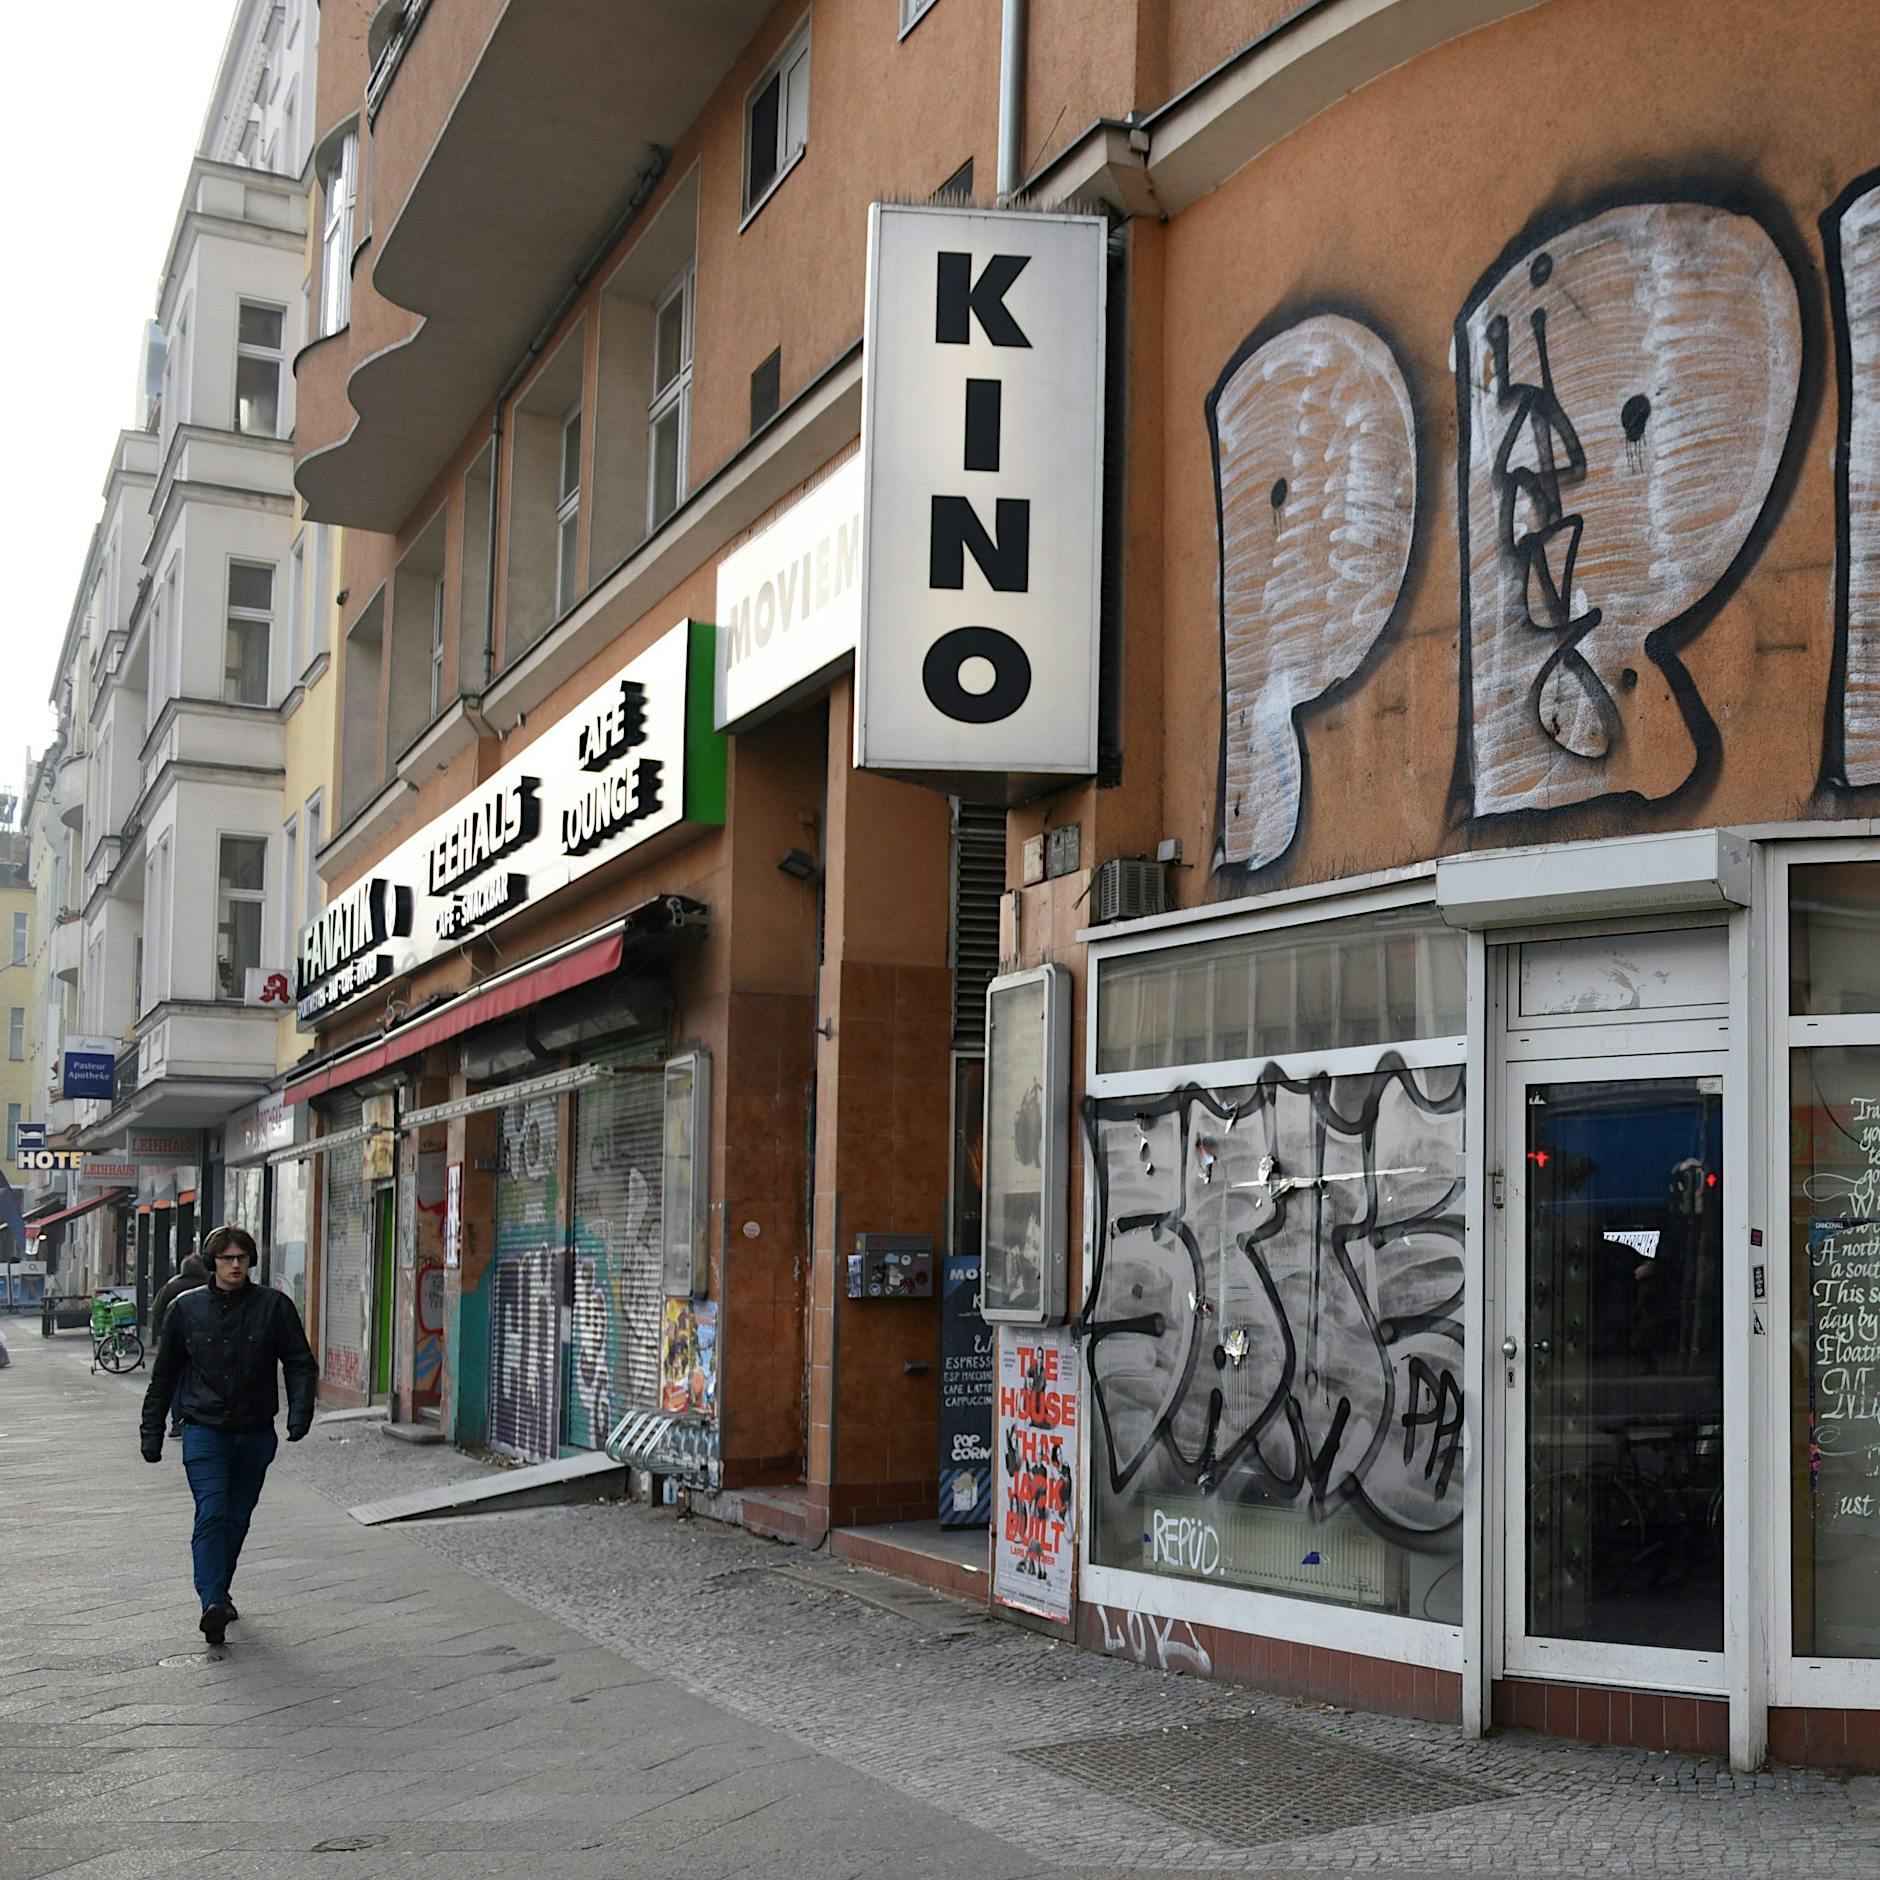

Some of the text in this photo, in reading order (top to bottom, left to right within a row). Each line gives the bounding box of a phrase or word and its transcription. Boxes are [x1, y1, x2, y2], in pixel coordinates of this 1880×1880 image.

[921, 251, 1034, 725] KINO
[557, 758, 641, 856] LOUNGE
[422, 776, 524, 895] TEEHAUS
[302, 880, 375, 988] FANATIK
[68, 1071, 111, 1080] Apotheke
[73, 1061, 106, 1071] Pasteur
[18, 1151, 92, 1169] HOTE
[132, 1138, 196, 1150] LEIHHAUS
[84, 1163, 135, 1176] LEIHHAUS
[1813, 1279, 1865, 1307] This
[1819, 1305, 1878, 1343] day by
[1017, 1346, 1058, 1382] THE
[1001, 1386, 1075, 1428] HOUSE
[951, 1447, 992, 1461] CORN
[953, 1434, 981, 1449] POP
[1016, 1430, 1064, 1469] THAT
[1008, 1470, 1066, 1513] JACK
[1005, 1510, 1066, 1554] BUILT
